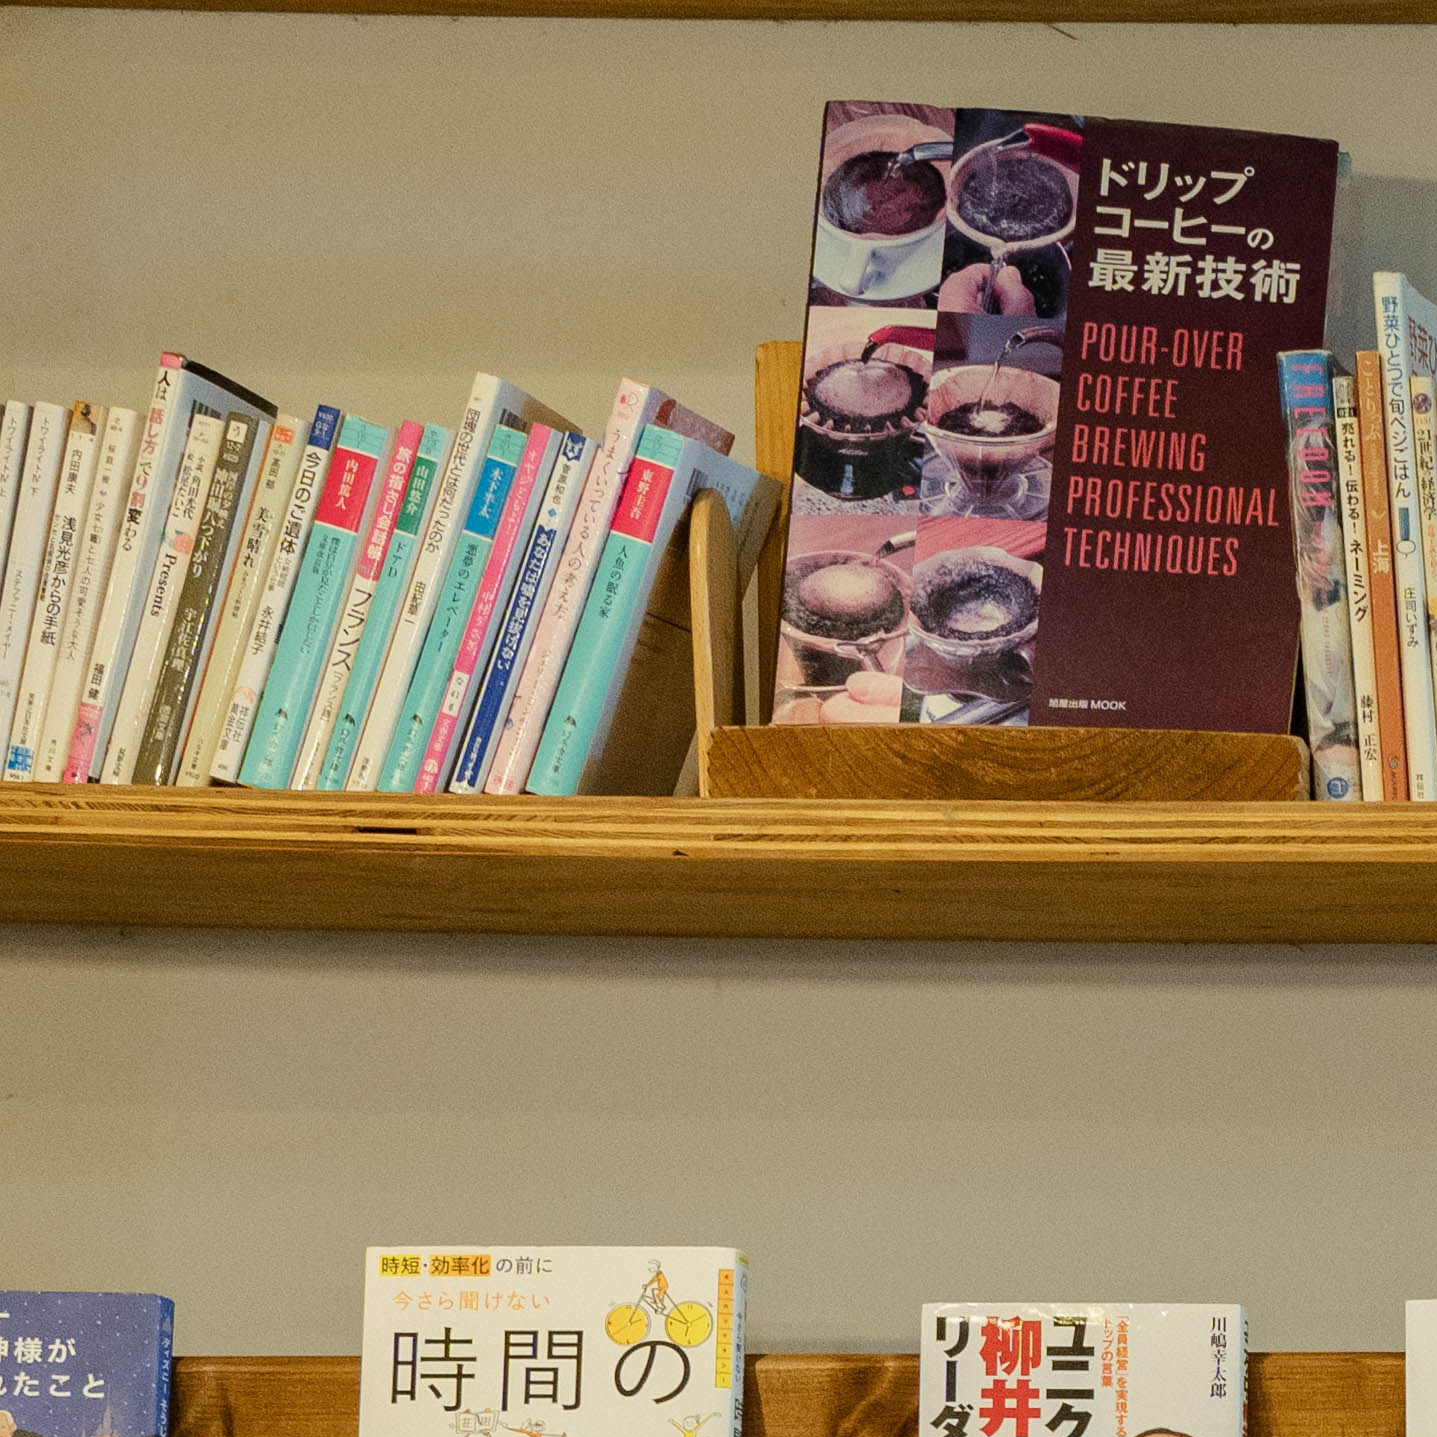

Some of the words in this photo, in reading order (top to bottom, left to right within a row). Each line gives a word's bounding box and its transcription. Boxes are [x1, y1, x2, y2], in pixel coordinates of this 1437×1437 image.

[1098, 159, 1254, 203] ドリップ
[1093, 206, 1275, 249] コーヒーの
[1089, 249, 1299, 304] 最新技術
[1081, 322, 1244, 371] POUR-OVER
[1076, 374, 1178, 418] COFFEE
[1071, 424, 1205, 472] BREWING
[1067, 476, 1279, 527] PROFESSIONAL
[1063, 528, 1238, 576] TECHNIQUES
[150, 554, 177, 616] Presents
[380, 1256, 553, 1276] 時短・効率化の前に
[391, 1290, 551, 1311] 今さら聞けない
[390, 1327, 691, 1412] 時間の
